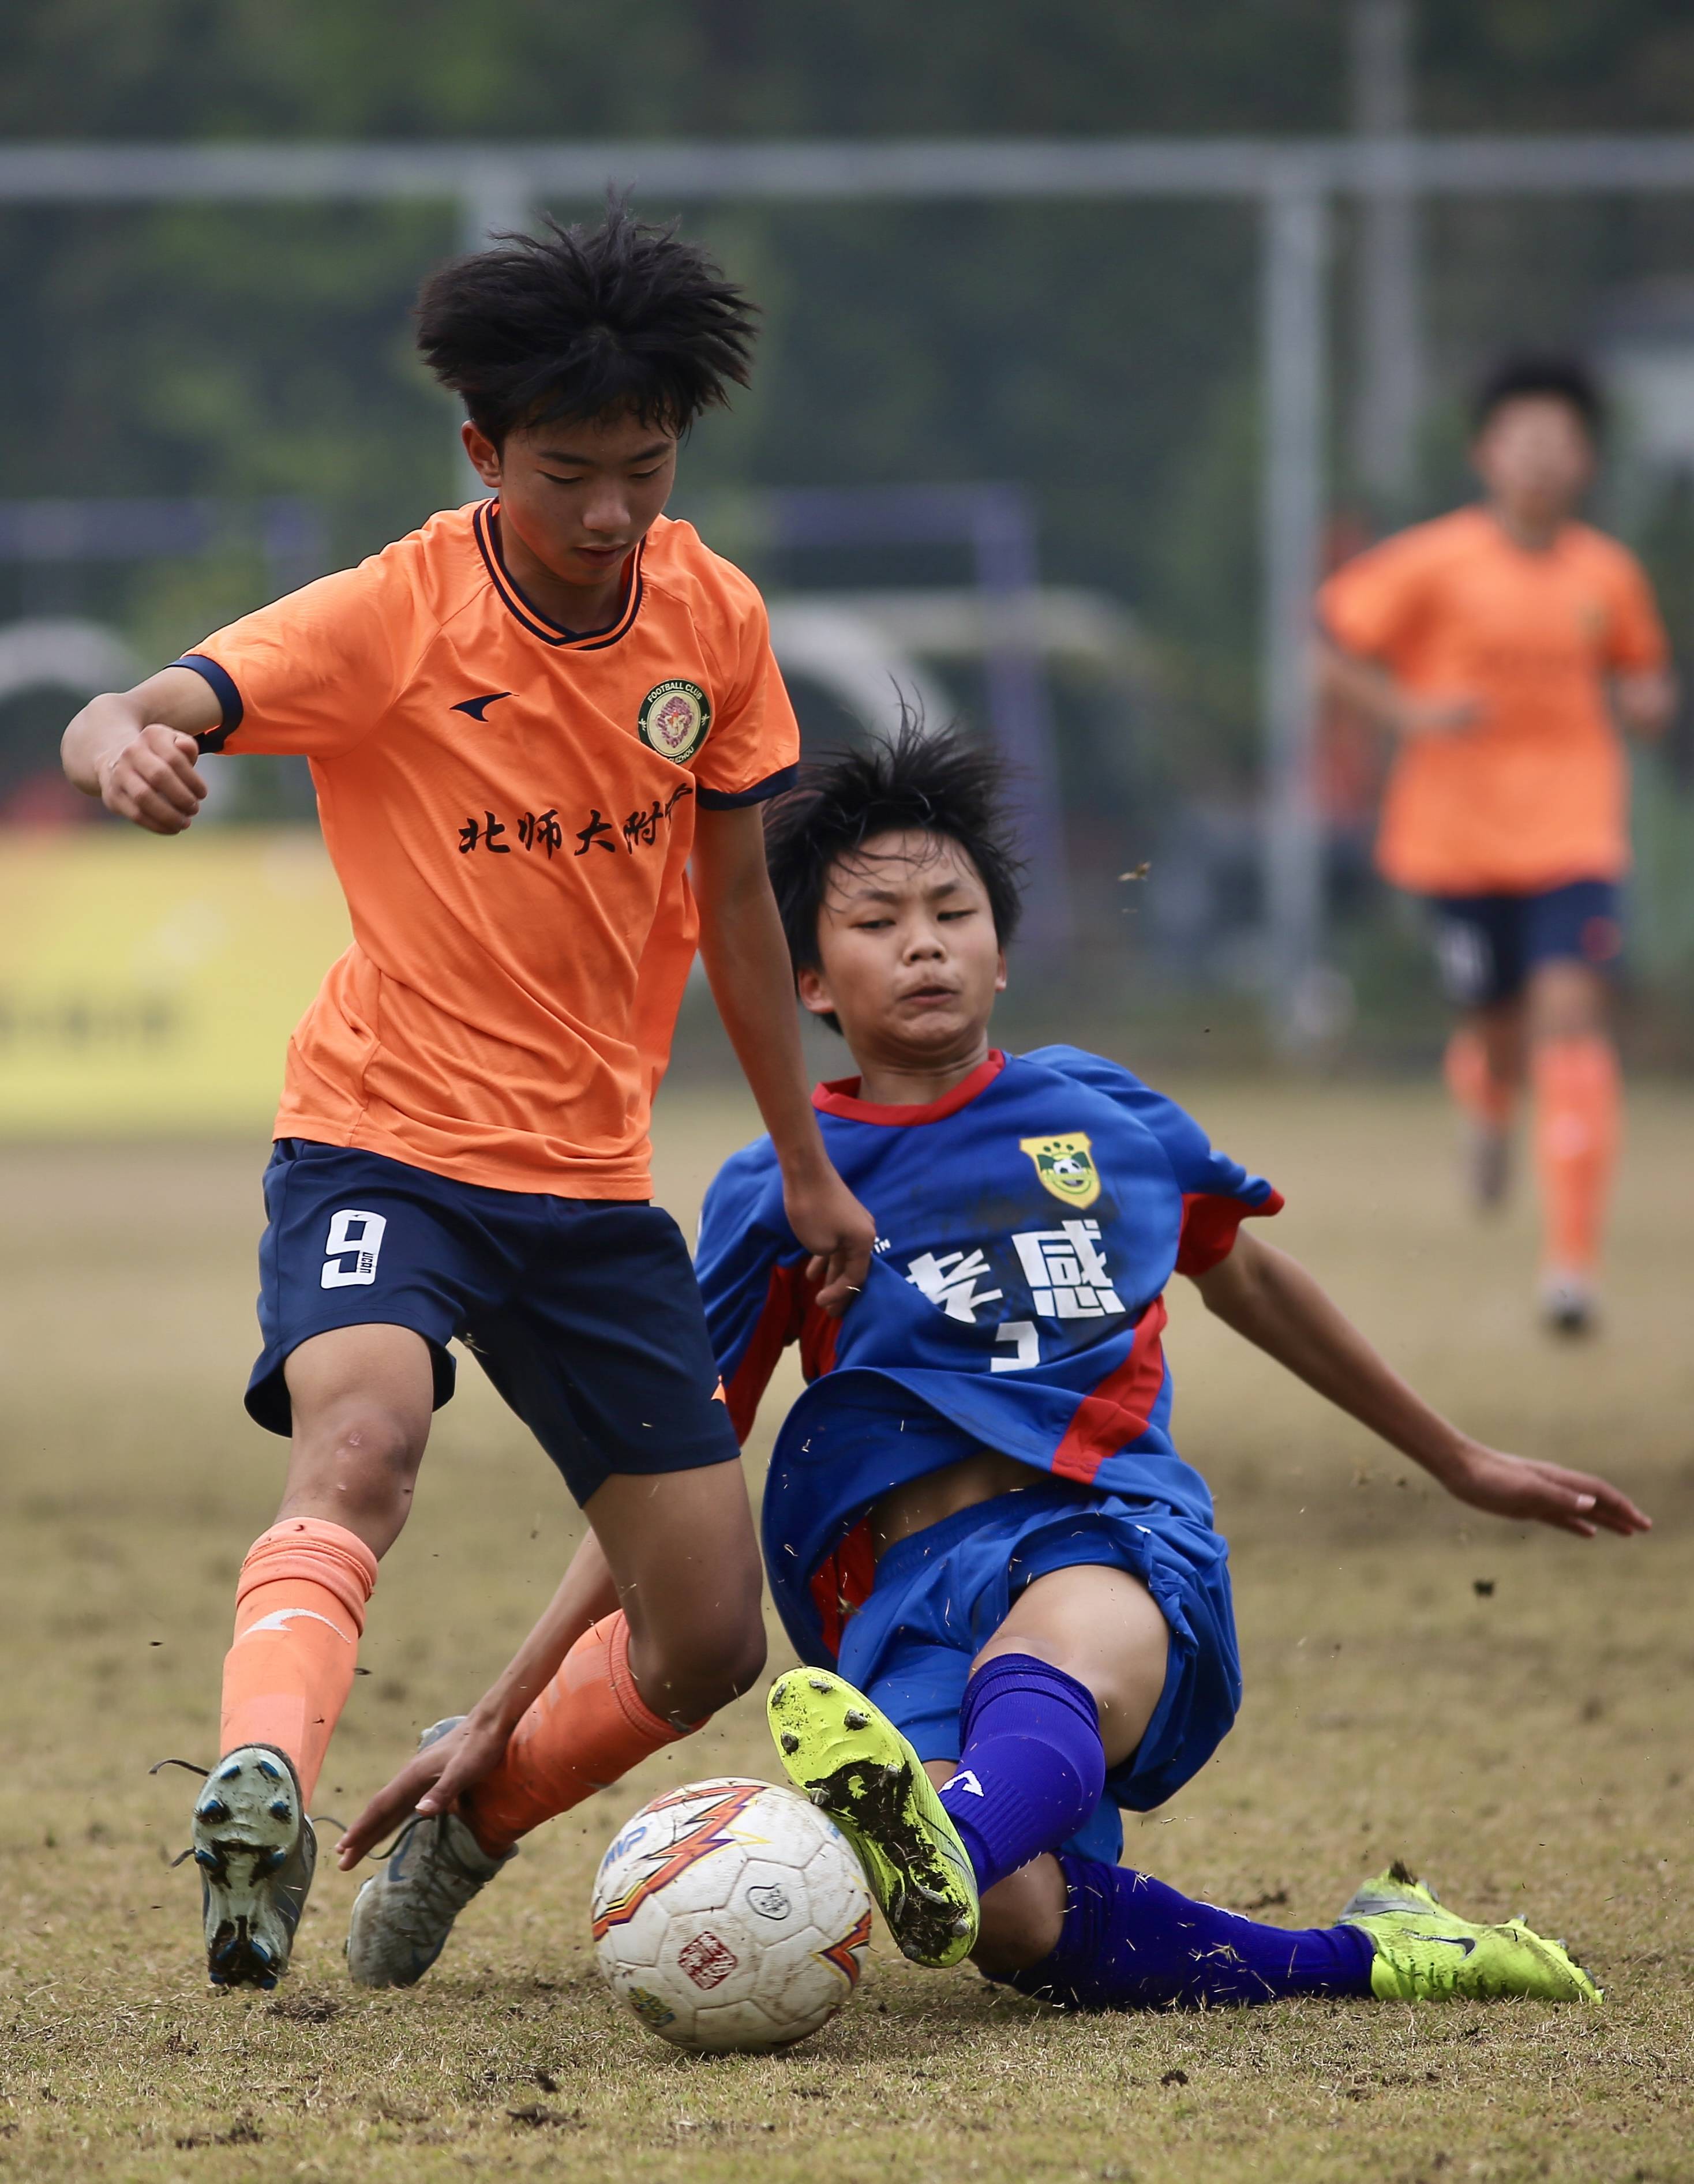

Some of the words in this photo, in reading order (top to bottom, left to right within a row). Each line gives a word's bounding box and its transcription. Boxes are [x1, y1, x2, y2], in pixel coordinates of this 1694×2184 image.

[647, 682, 684, 703] FOOTBALL
[685, 684, 703, 700] CLUB
[320, 1209, 387, 1289] 9
